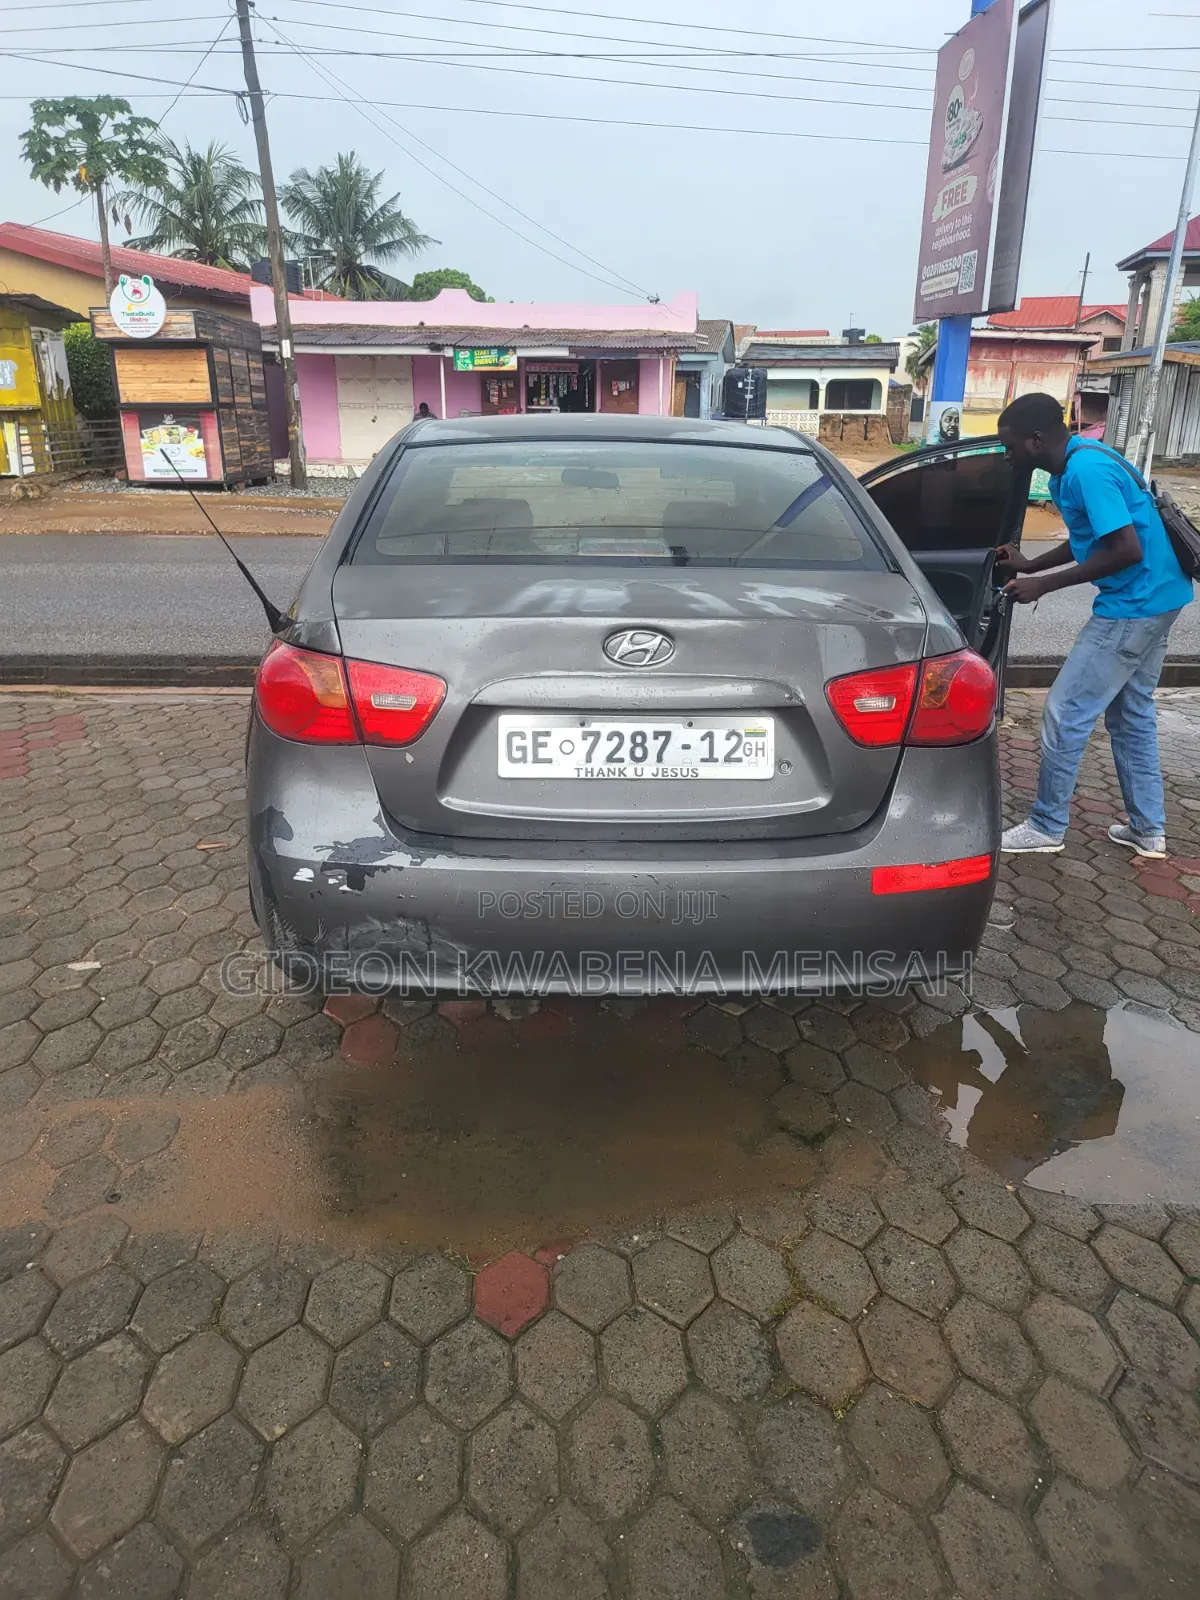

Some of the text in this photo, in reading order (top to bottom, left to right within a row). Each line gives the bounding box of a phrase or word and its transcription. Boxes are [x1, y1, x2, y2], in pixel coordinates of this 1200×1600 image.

[942, 180, 968, 211] FREE
[935, 211, 972, 237] delivery to this
[506, 730, 552, 764] GE
[742, 740, 766, 758] GH
[574, 767, 700, 778] THANK U JESUS
